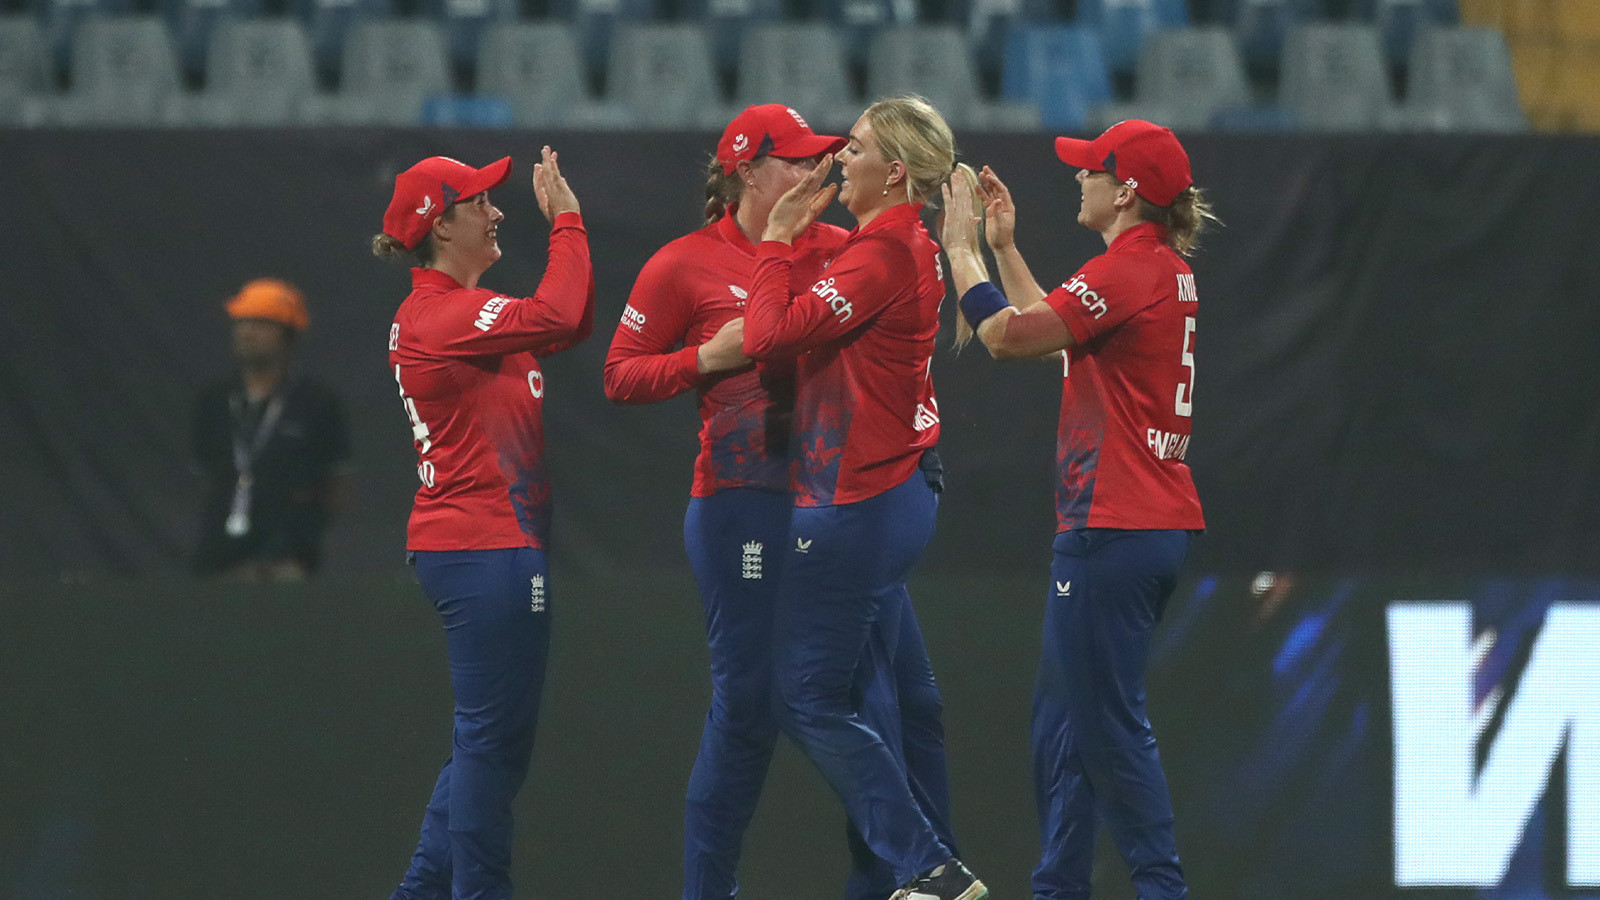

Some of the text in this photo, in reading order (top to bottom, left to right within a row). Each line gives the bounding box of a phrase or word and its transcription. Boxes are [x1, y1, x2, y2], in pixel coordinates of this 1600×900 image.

[1125, 177, 1138, 189] 29
[811, 277, 853, 323] cinch
[1175, 316, 1196, 417] 5
